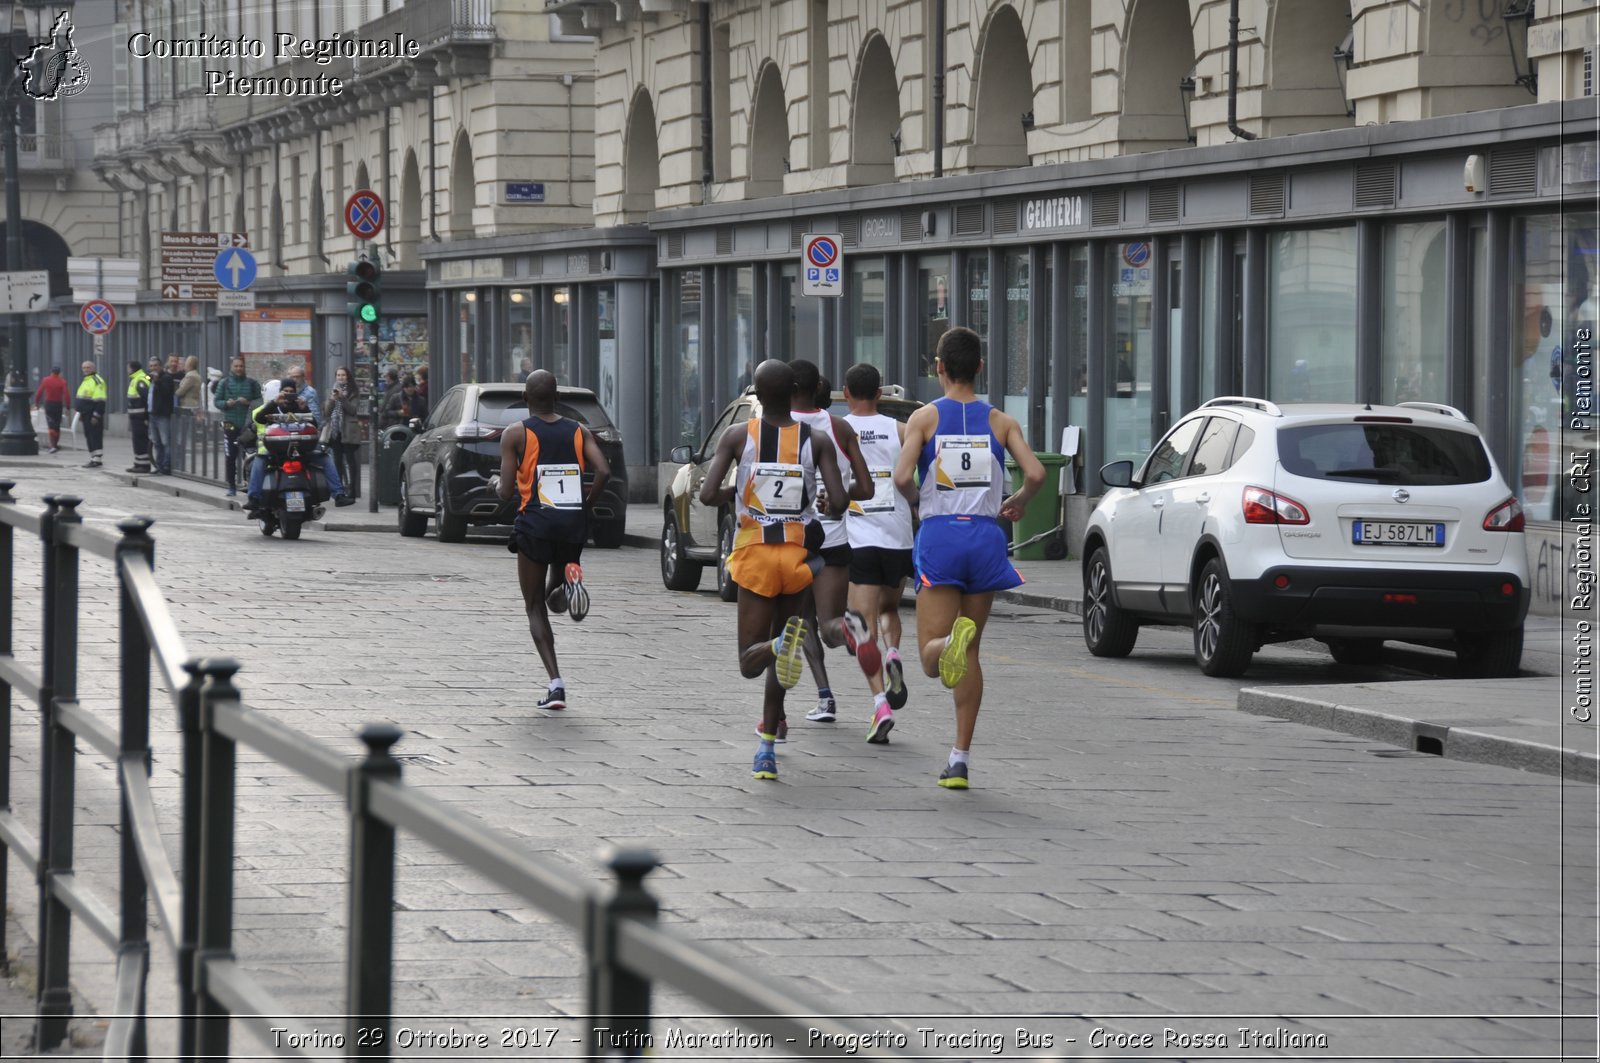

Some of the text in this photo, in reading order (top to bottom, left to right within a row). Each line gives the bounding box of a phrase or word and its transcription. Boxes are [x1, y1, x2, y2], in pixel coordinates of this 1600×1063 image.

[1026, 195, 1082, 230] GELATERIA
[860, 434, 889, 442] MARATHON
[961, 452, 971, 471] 8
[557, 479, 564, 493] 1
[773, 480, 784, 499] 2
[1363, 523, 1383, 540] EJ
[1387, 524, 1435, 542] 587LM
